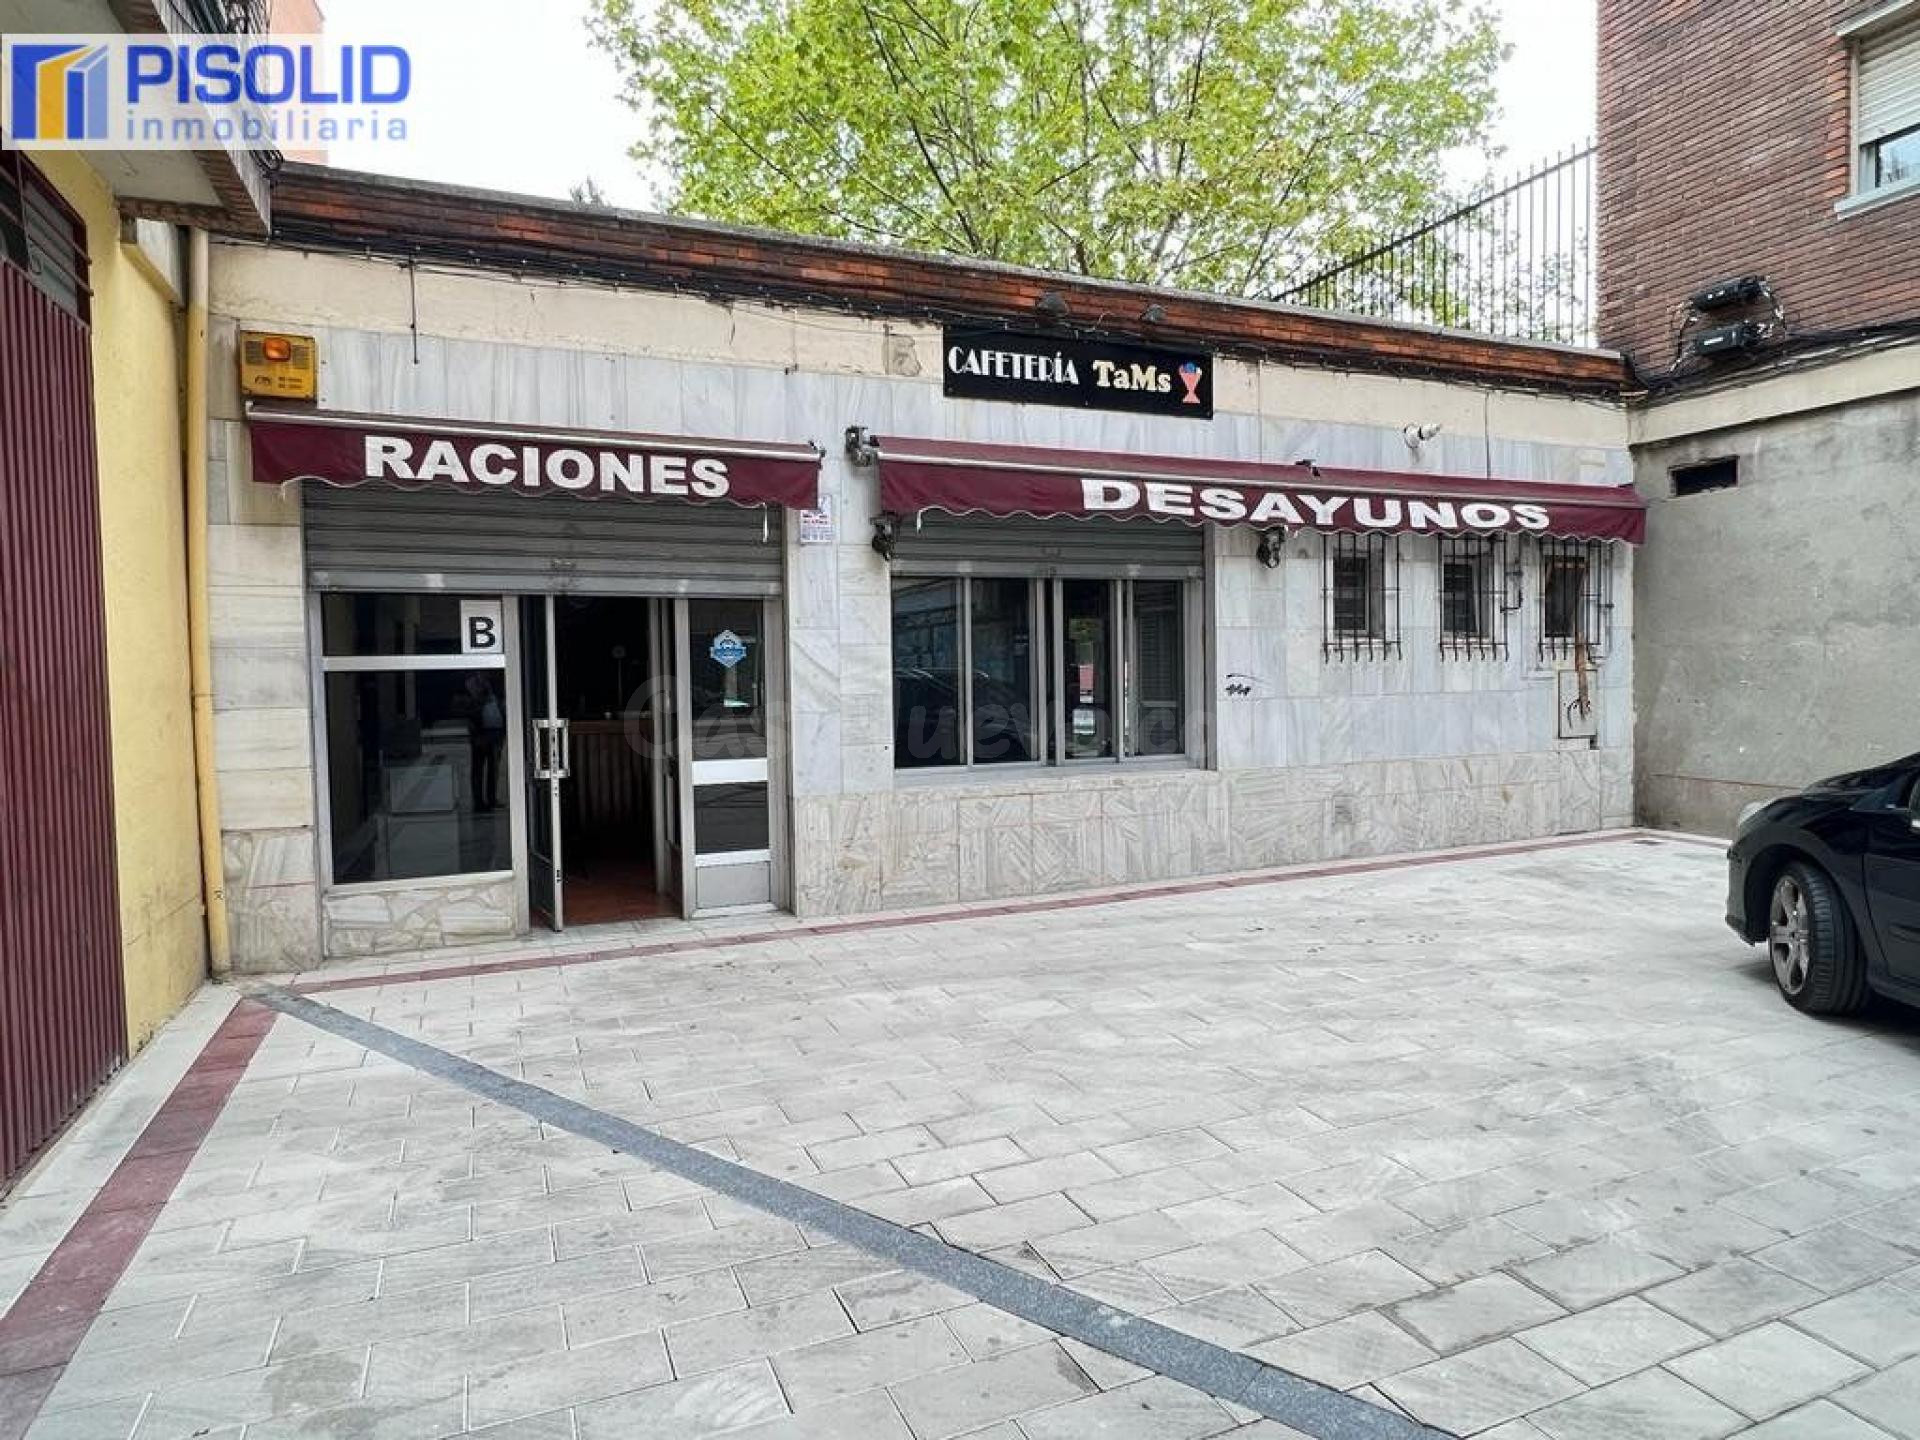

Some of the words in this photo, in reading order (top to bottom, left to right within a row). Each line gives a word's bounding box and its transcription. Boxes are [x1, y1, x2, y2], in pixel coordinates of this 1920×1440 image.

[948, 346, 1080, 385] CAFETERÍA
[1092, 359, 1172, 393] TaMs
[364, 434, 731, 499] RACIONES
[1080, 478, 1551, 531] DESAYUNOS
[469, 616, 496, 648] B
